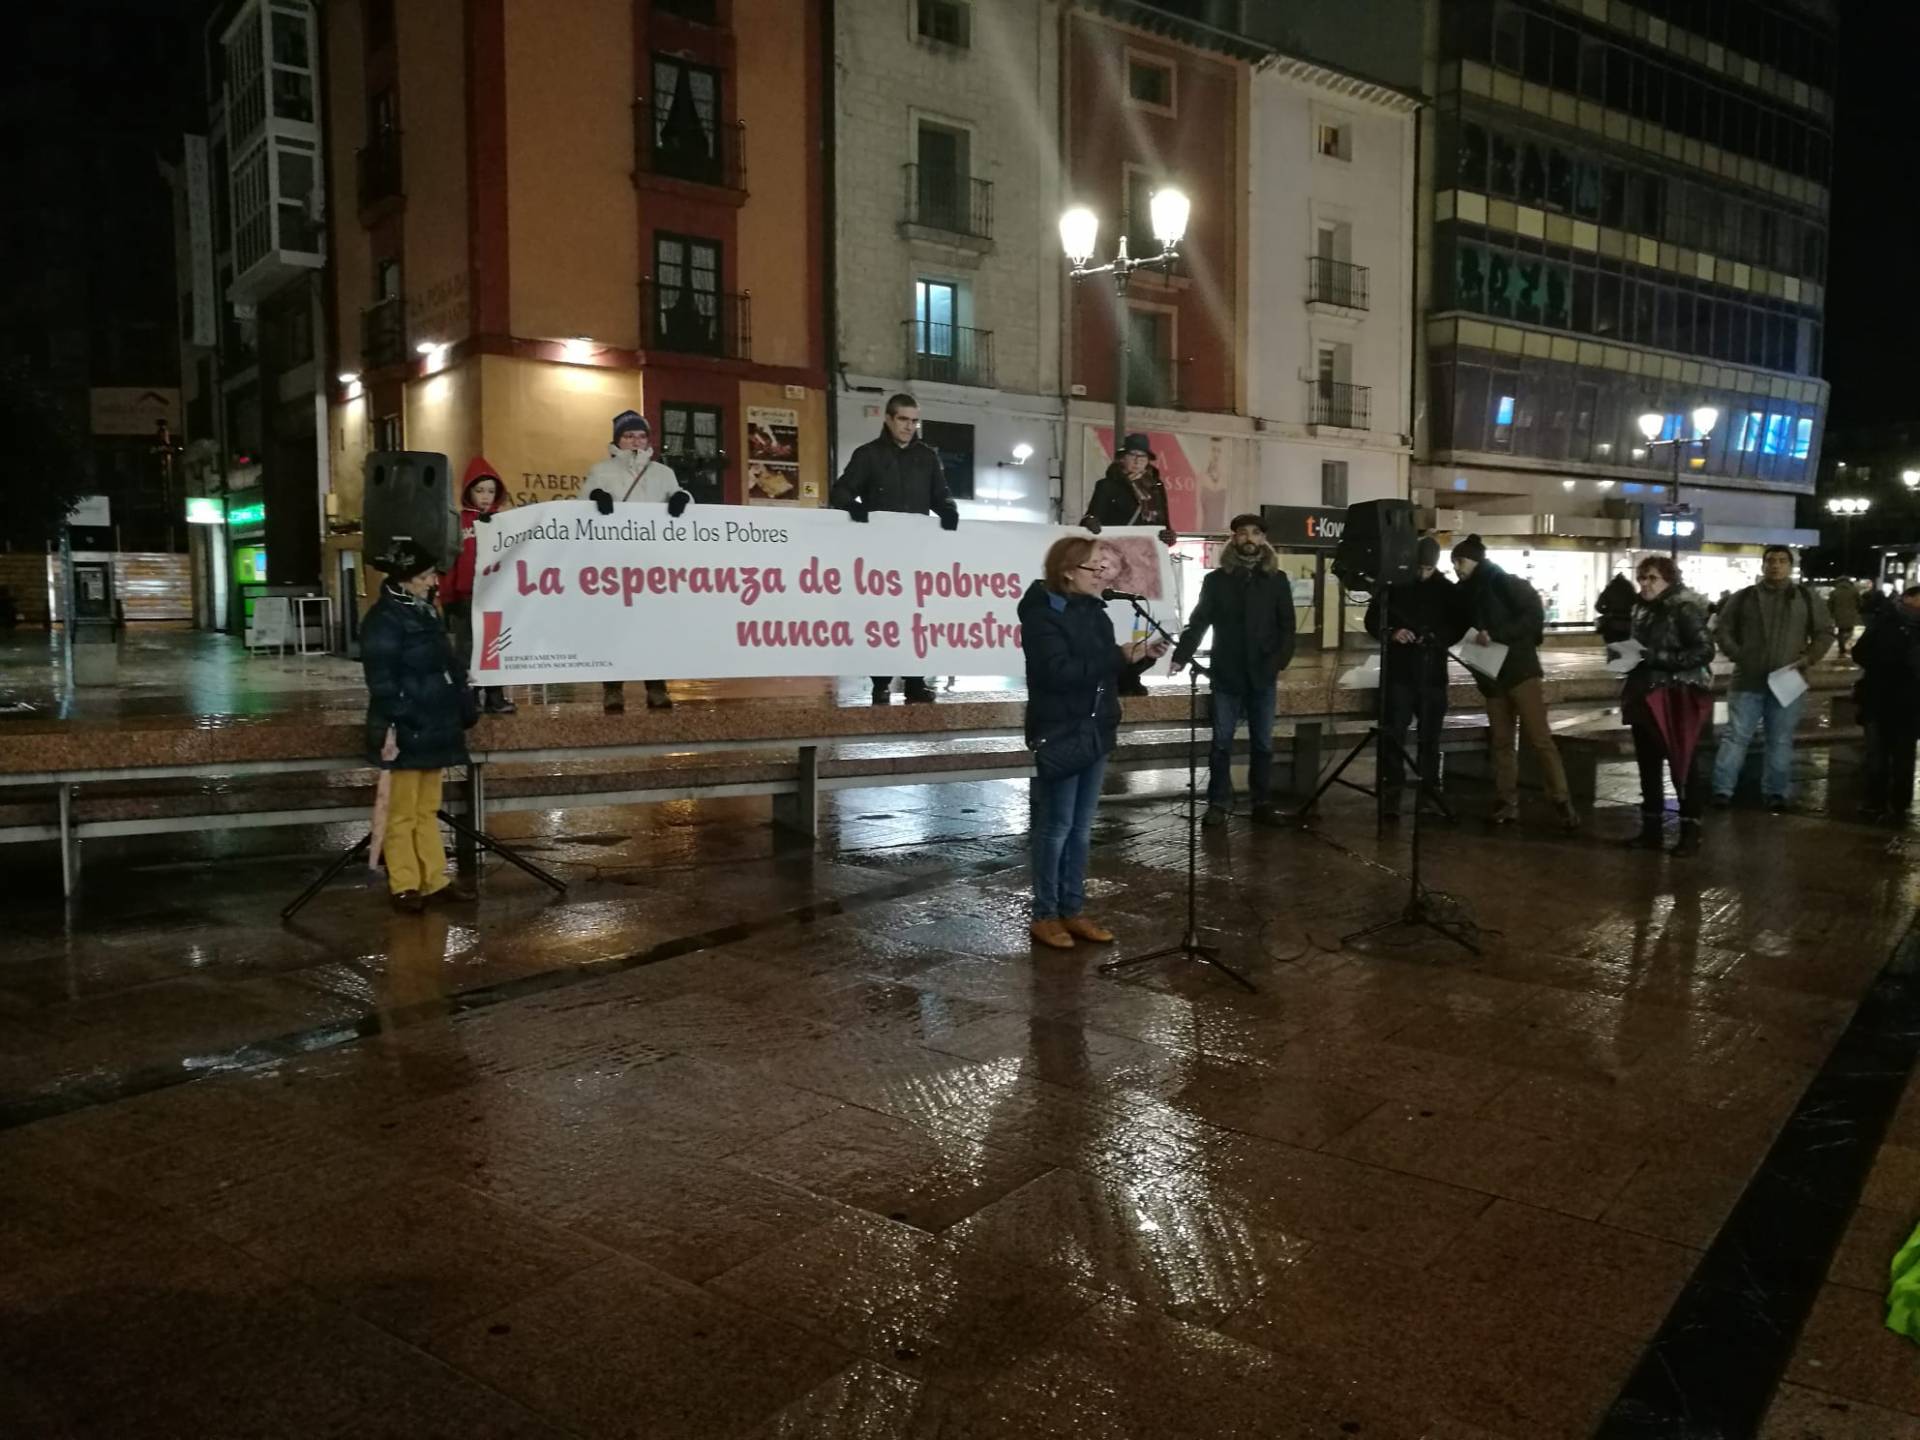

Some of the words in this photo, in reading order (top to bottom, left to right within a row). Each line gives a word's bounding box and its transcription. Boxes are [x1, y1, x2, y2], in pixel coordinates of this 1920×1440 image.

[522, 473, 587, 490] TABER
[492, 517, 570, 553] Jornada
[575, 517, 657, 542] Mundial
[662, 520, 687, 542] de
[692, 520, 721, 543] los
[725, 521, 789, 544] Pobres
[1306, 515, 1345, 538] t-Kow
[578, 566, 786, 606] esperanza
[799, 556, 842, 595] de
[854, 556, 903, 597] los
[915, 561, 1022, 607] pobres
[736, 619, 855, 648] nunca
[865, 619, 900, 648] se
[504, 653, 567, 662] DEPARTAMENTO
